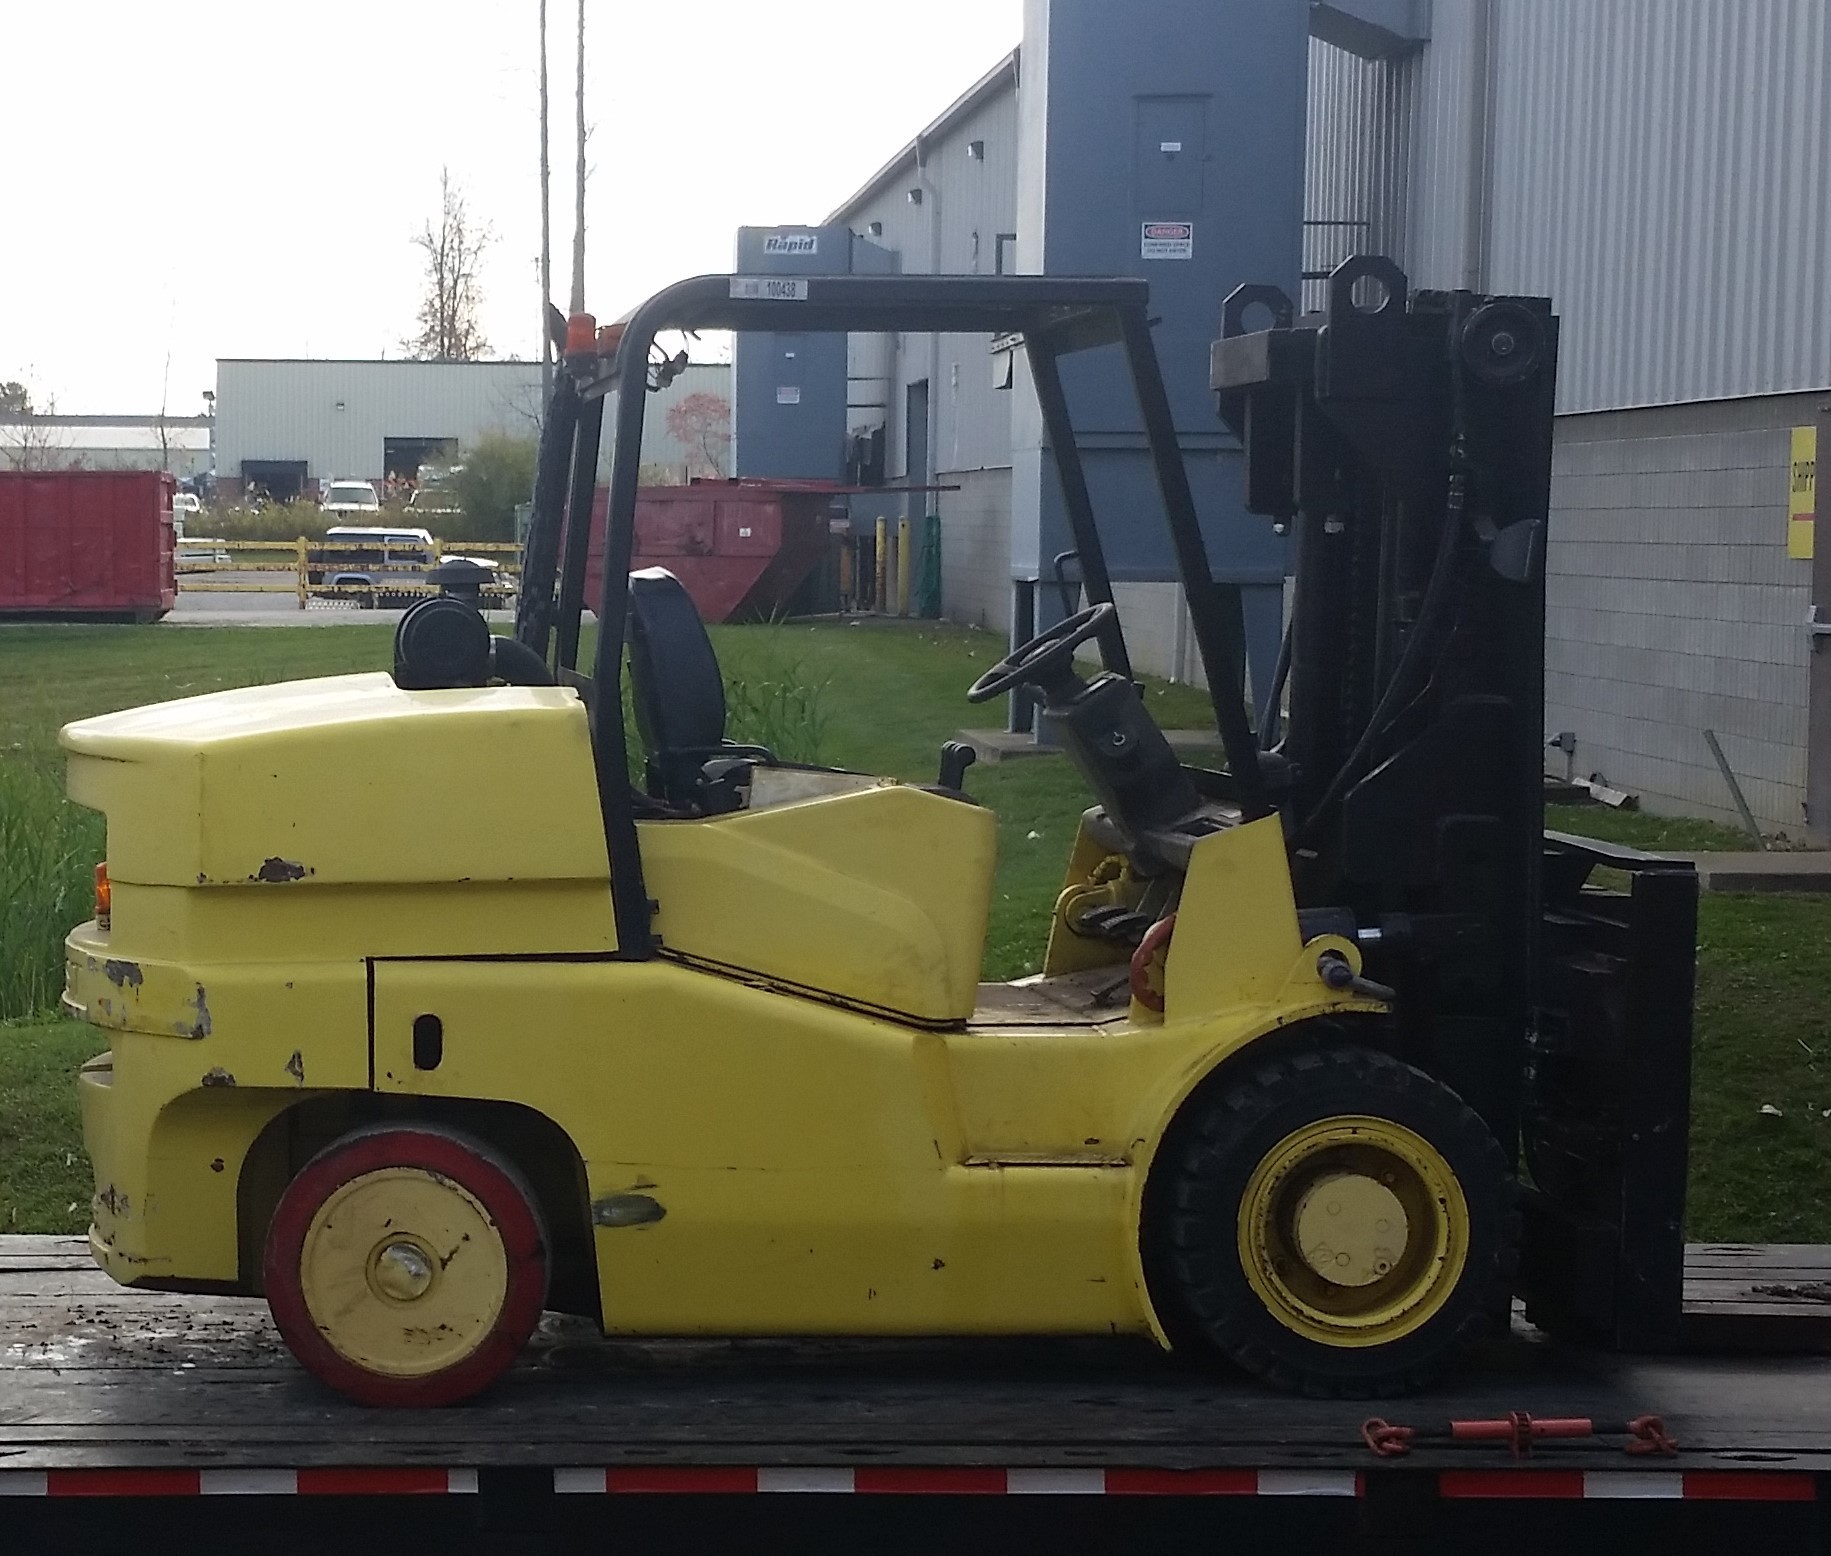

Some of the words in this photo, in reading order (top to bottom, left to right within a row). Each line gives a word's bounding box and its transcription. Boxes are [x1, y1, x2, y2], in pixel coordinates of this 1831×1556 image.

[1150, 227, 1184, 236] DANGER
[765, 237, 815, 251] Rapid
[767, 281, 796, 298] 100438
